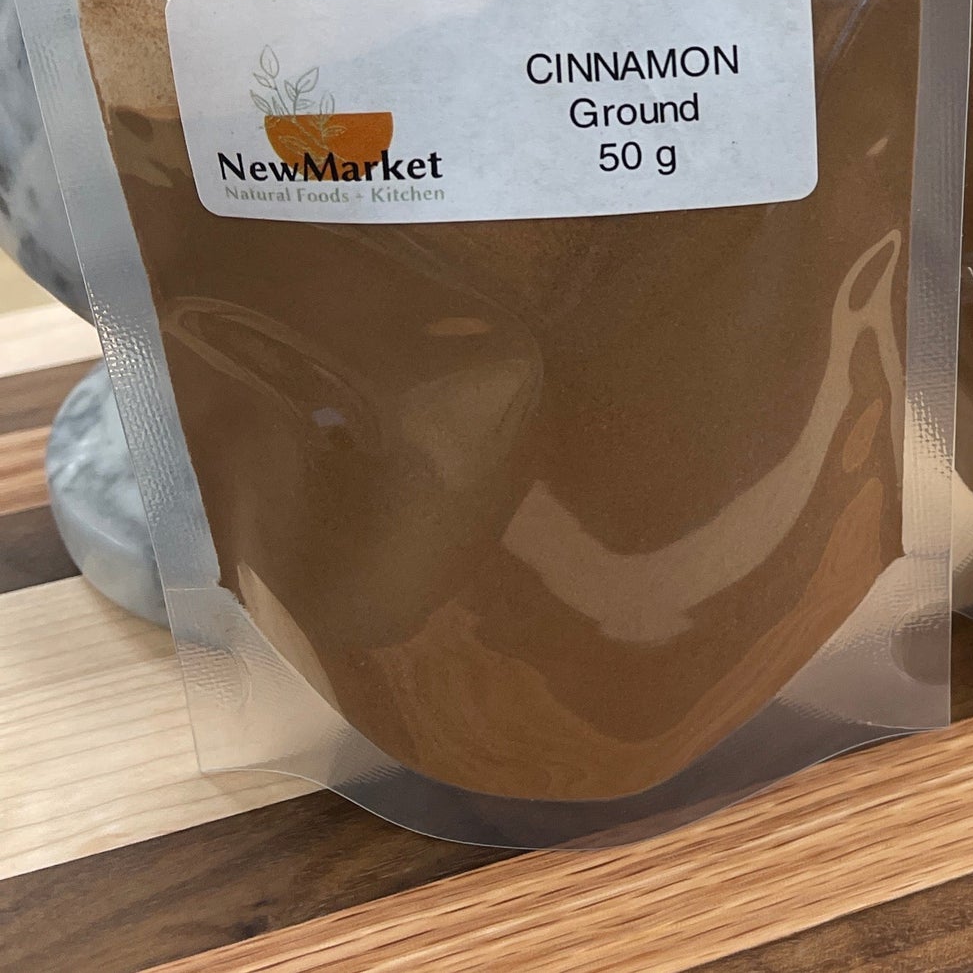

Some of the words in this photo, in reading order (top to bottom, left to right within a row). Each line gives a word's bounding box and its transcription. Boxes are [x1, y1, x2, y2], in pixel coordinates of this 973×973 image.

[526, 44, 739, 84] CINNAMON
[569, 92, 701, 129] Ground
[217, 150, 443, 182] NewMarket
[599, 141, 644, 173] 50
[655, 144, 678, 176] g
[225, 185, 291, 203] Natural
[296, 184, 350, 204] Foods
[370, 183, 446, 203] Kitchen
